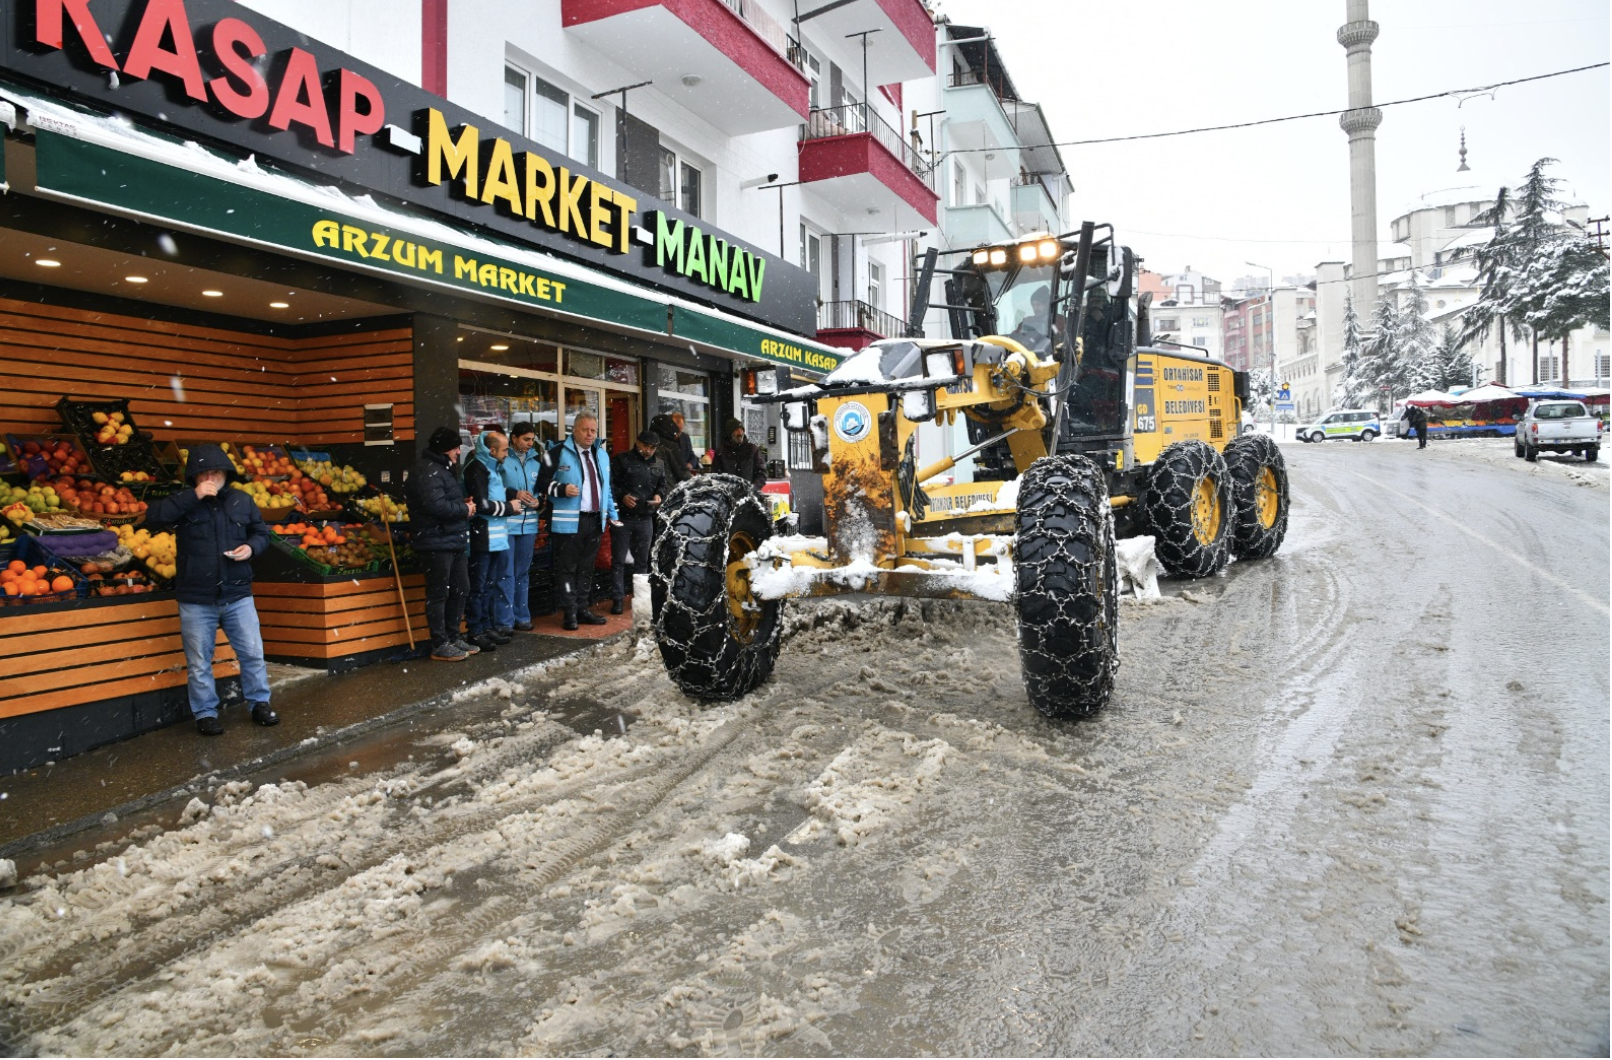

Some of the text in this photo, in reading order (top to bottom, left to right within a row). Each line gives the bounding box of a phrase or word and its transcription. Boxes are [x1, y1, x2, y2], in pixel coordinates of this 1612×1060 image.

[428, 107, 637, 254] MARKET
[657, 210, 766, 303] MANAV
[312, 220, 567, 304] ARZUM MARKET
[761, 339, 837, 371] ARZUM KASAP
[1164, 366, 1203, 381] ORTAHİSAR
[1138, 404, 1147, 414] GD
[1166, 399, 1204, 414] BELEDİYESİ
[1137, 416, 1155, 430] 675
